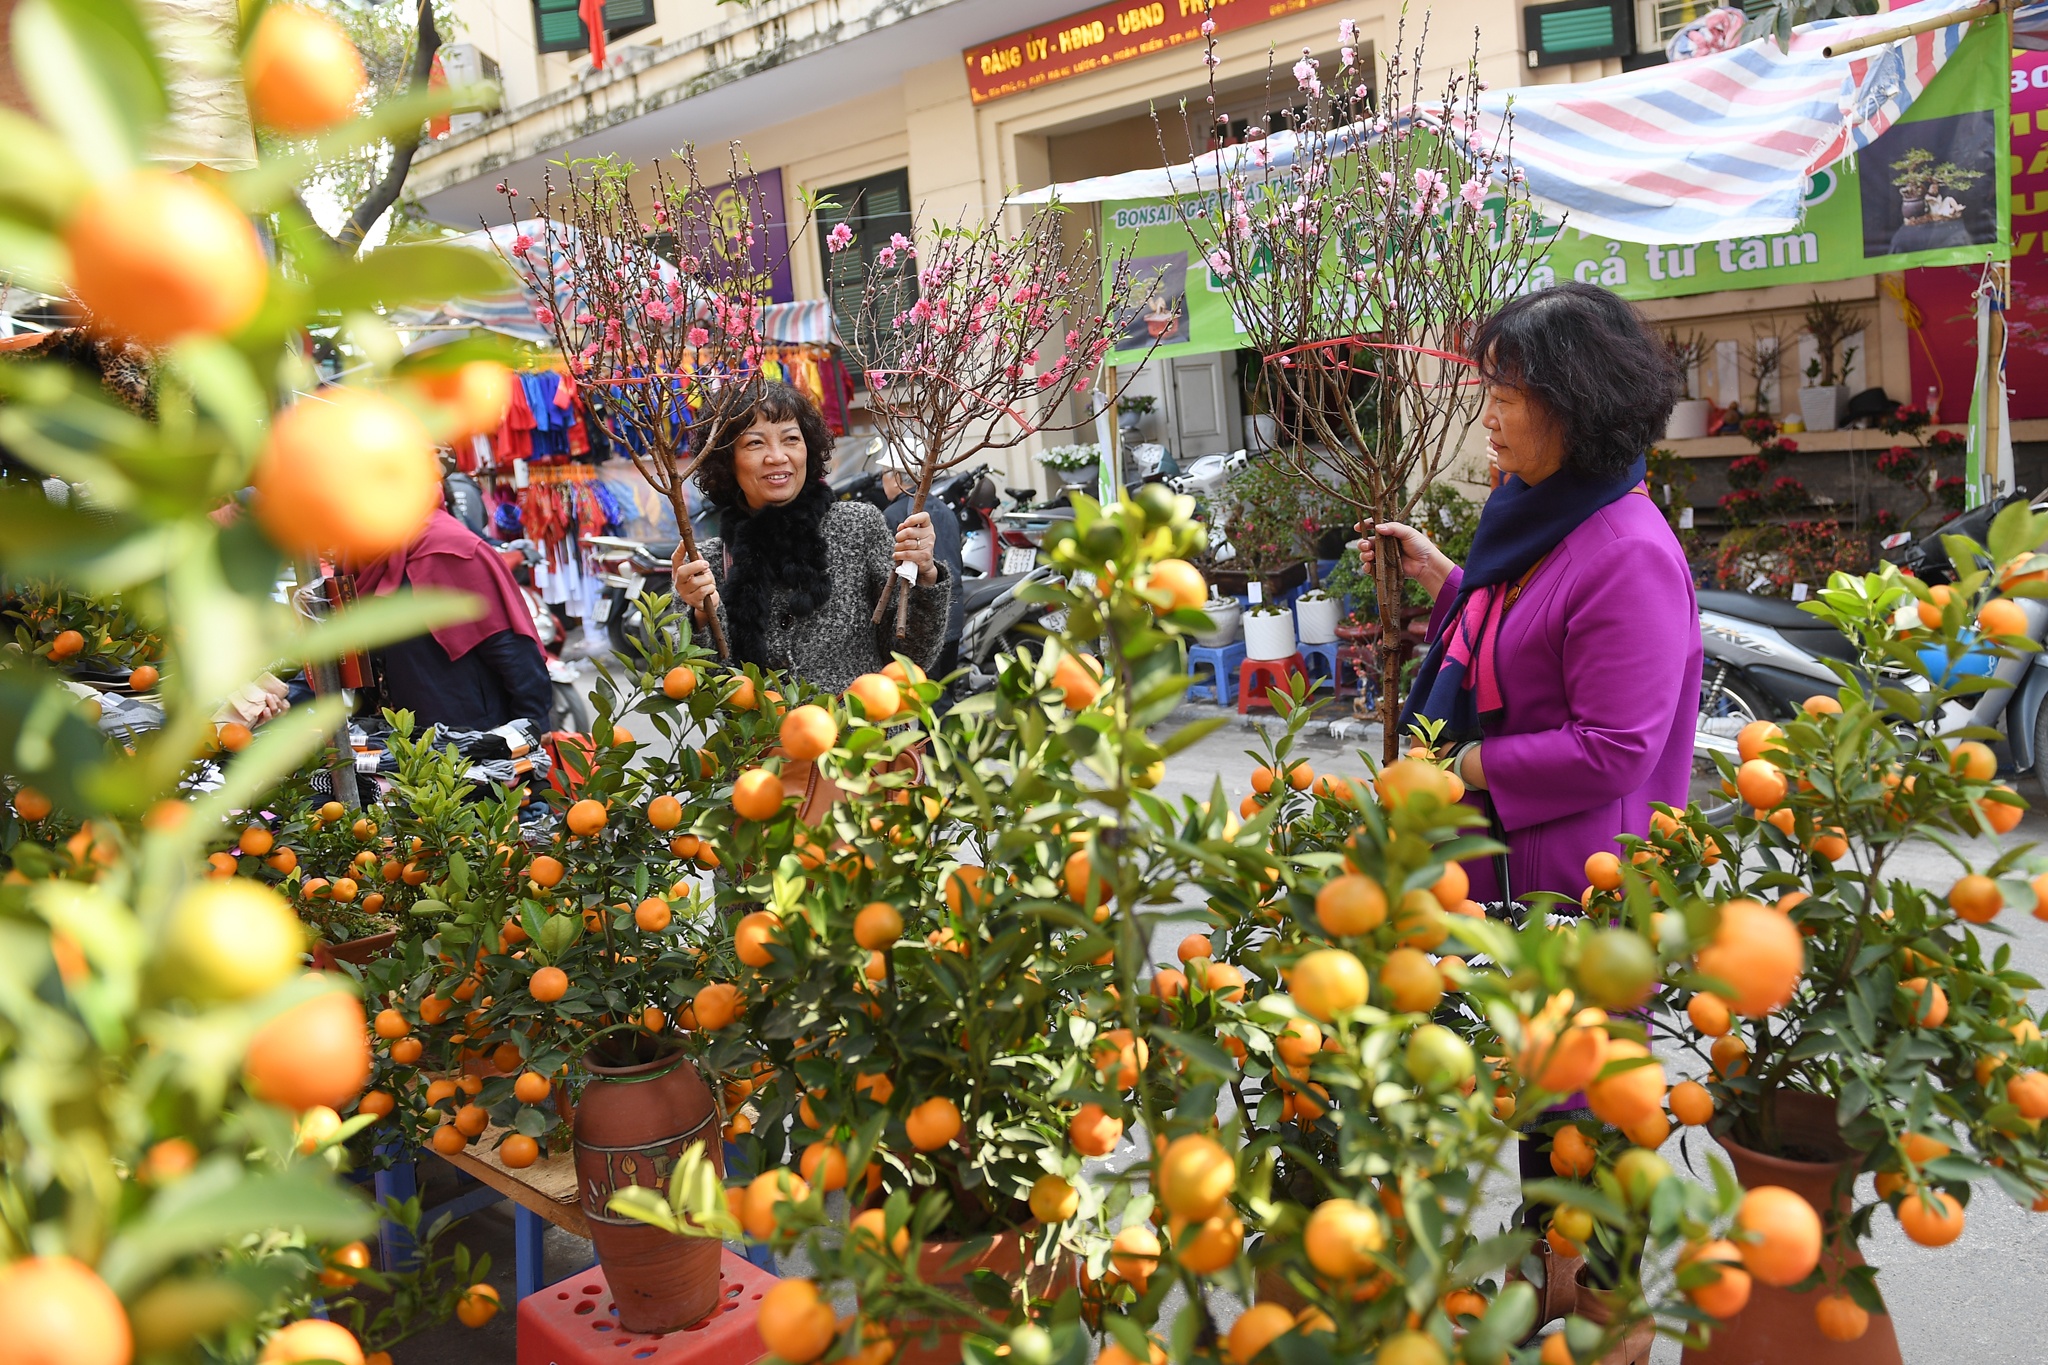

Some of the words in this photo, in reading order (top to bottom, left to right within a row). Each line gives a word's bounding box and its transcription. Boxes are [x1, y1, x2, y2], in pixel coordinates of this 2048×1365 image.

[981, 47, 1022, 76] ĐẢNG
[1026, 34, 1048, 62] ỦY
[1058, 20, 1105, 54] HĐND
[1117, 1, 1165, 36] UBND
[1117, 205, 1171, 227] BONSAI
[1573, 242, 1628, 287] cả
[1715, 232, 1818, 273] tâm
